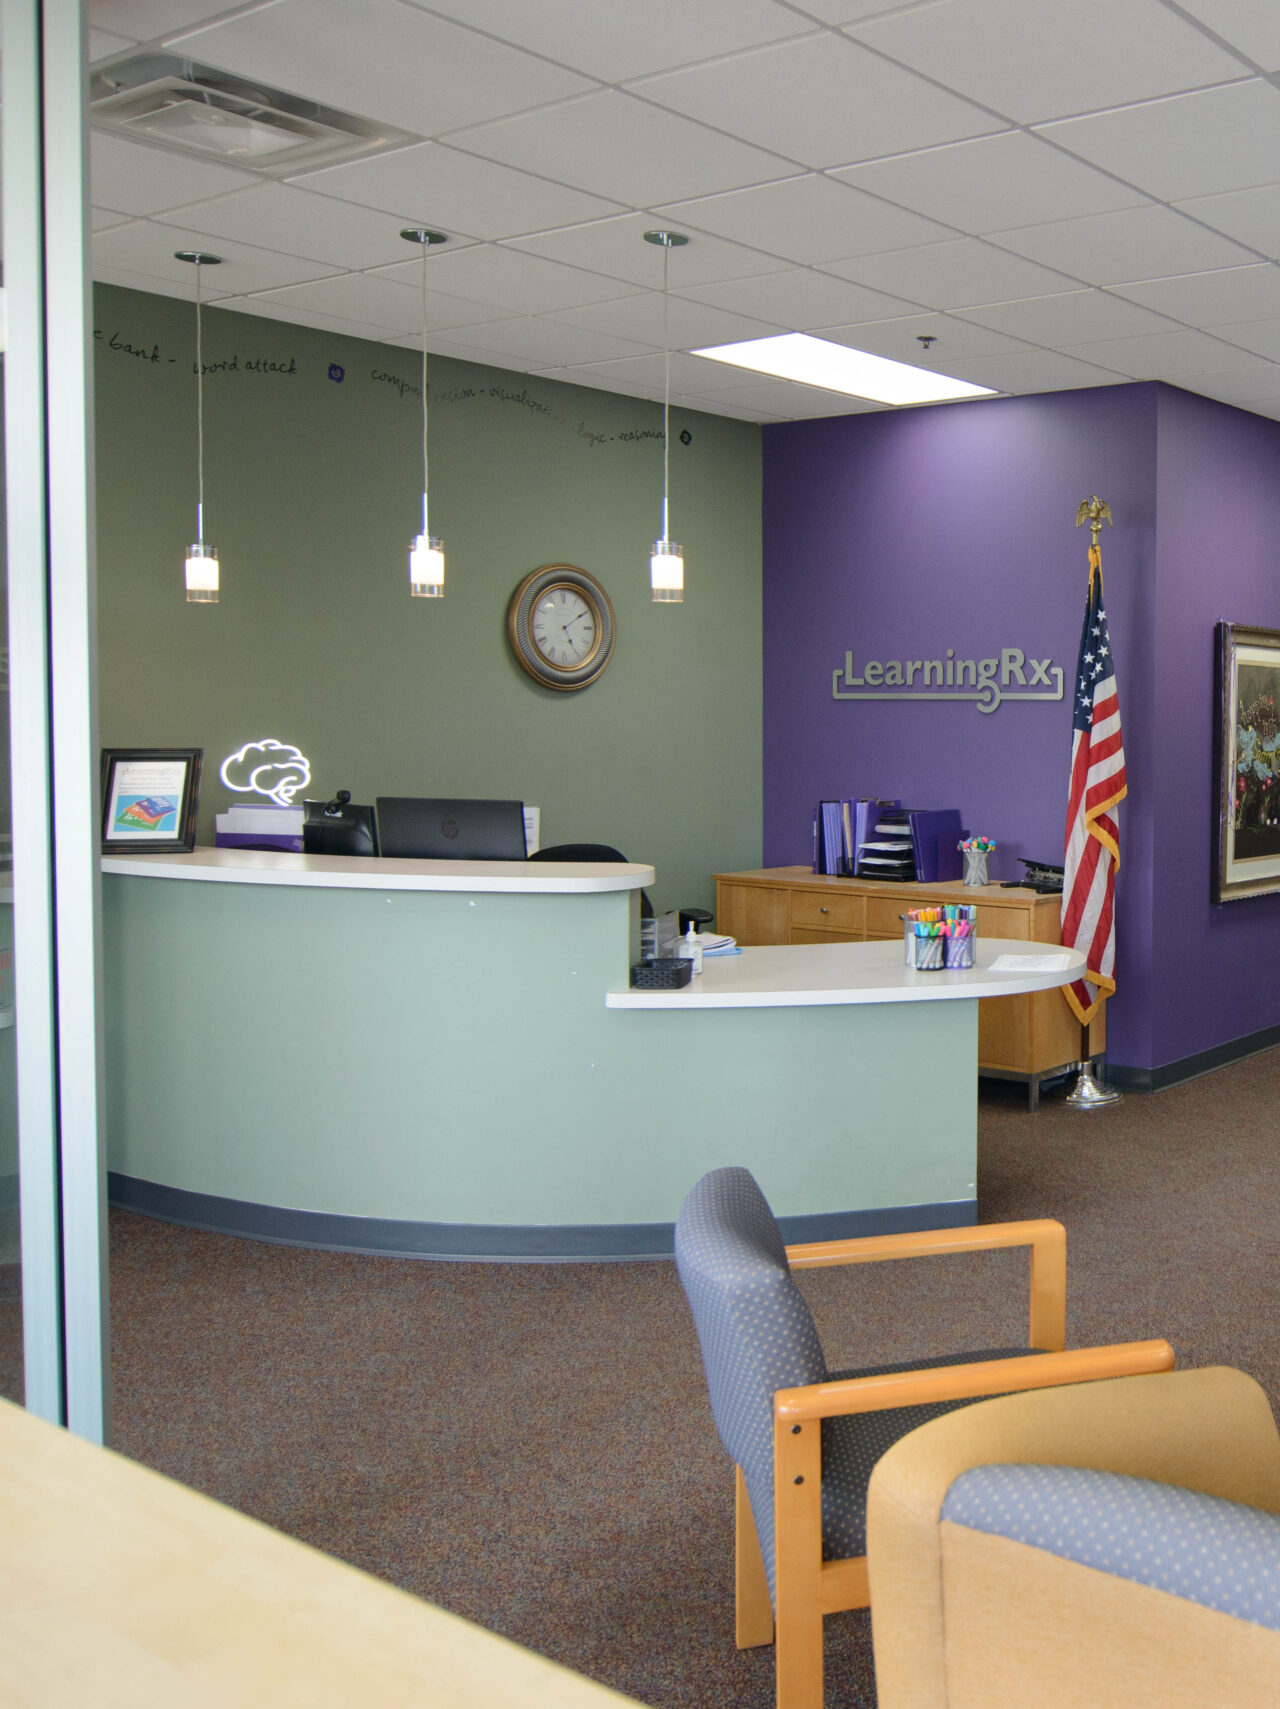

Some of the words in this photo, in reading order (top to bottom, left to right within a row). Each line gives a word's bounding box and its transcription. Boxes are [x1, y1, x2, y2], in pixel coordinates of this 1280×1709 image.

[109, 332, 160, 363] bank
[194, 355, 240, 375] word
[245, 358, 297, 375] attack
[845, 648, 1052, 713] LearningRx
